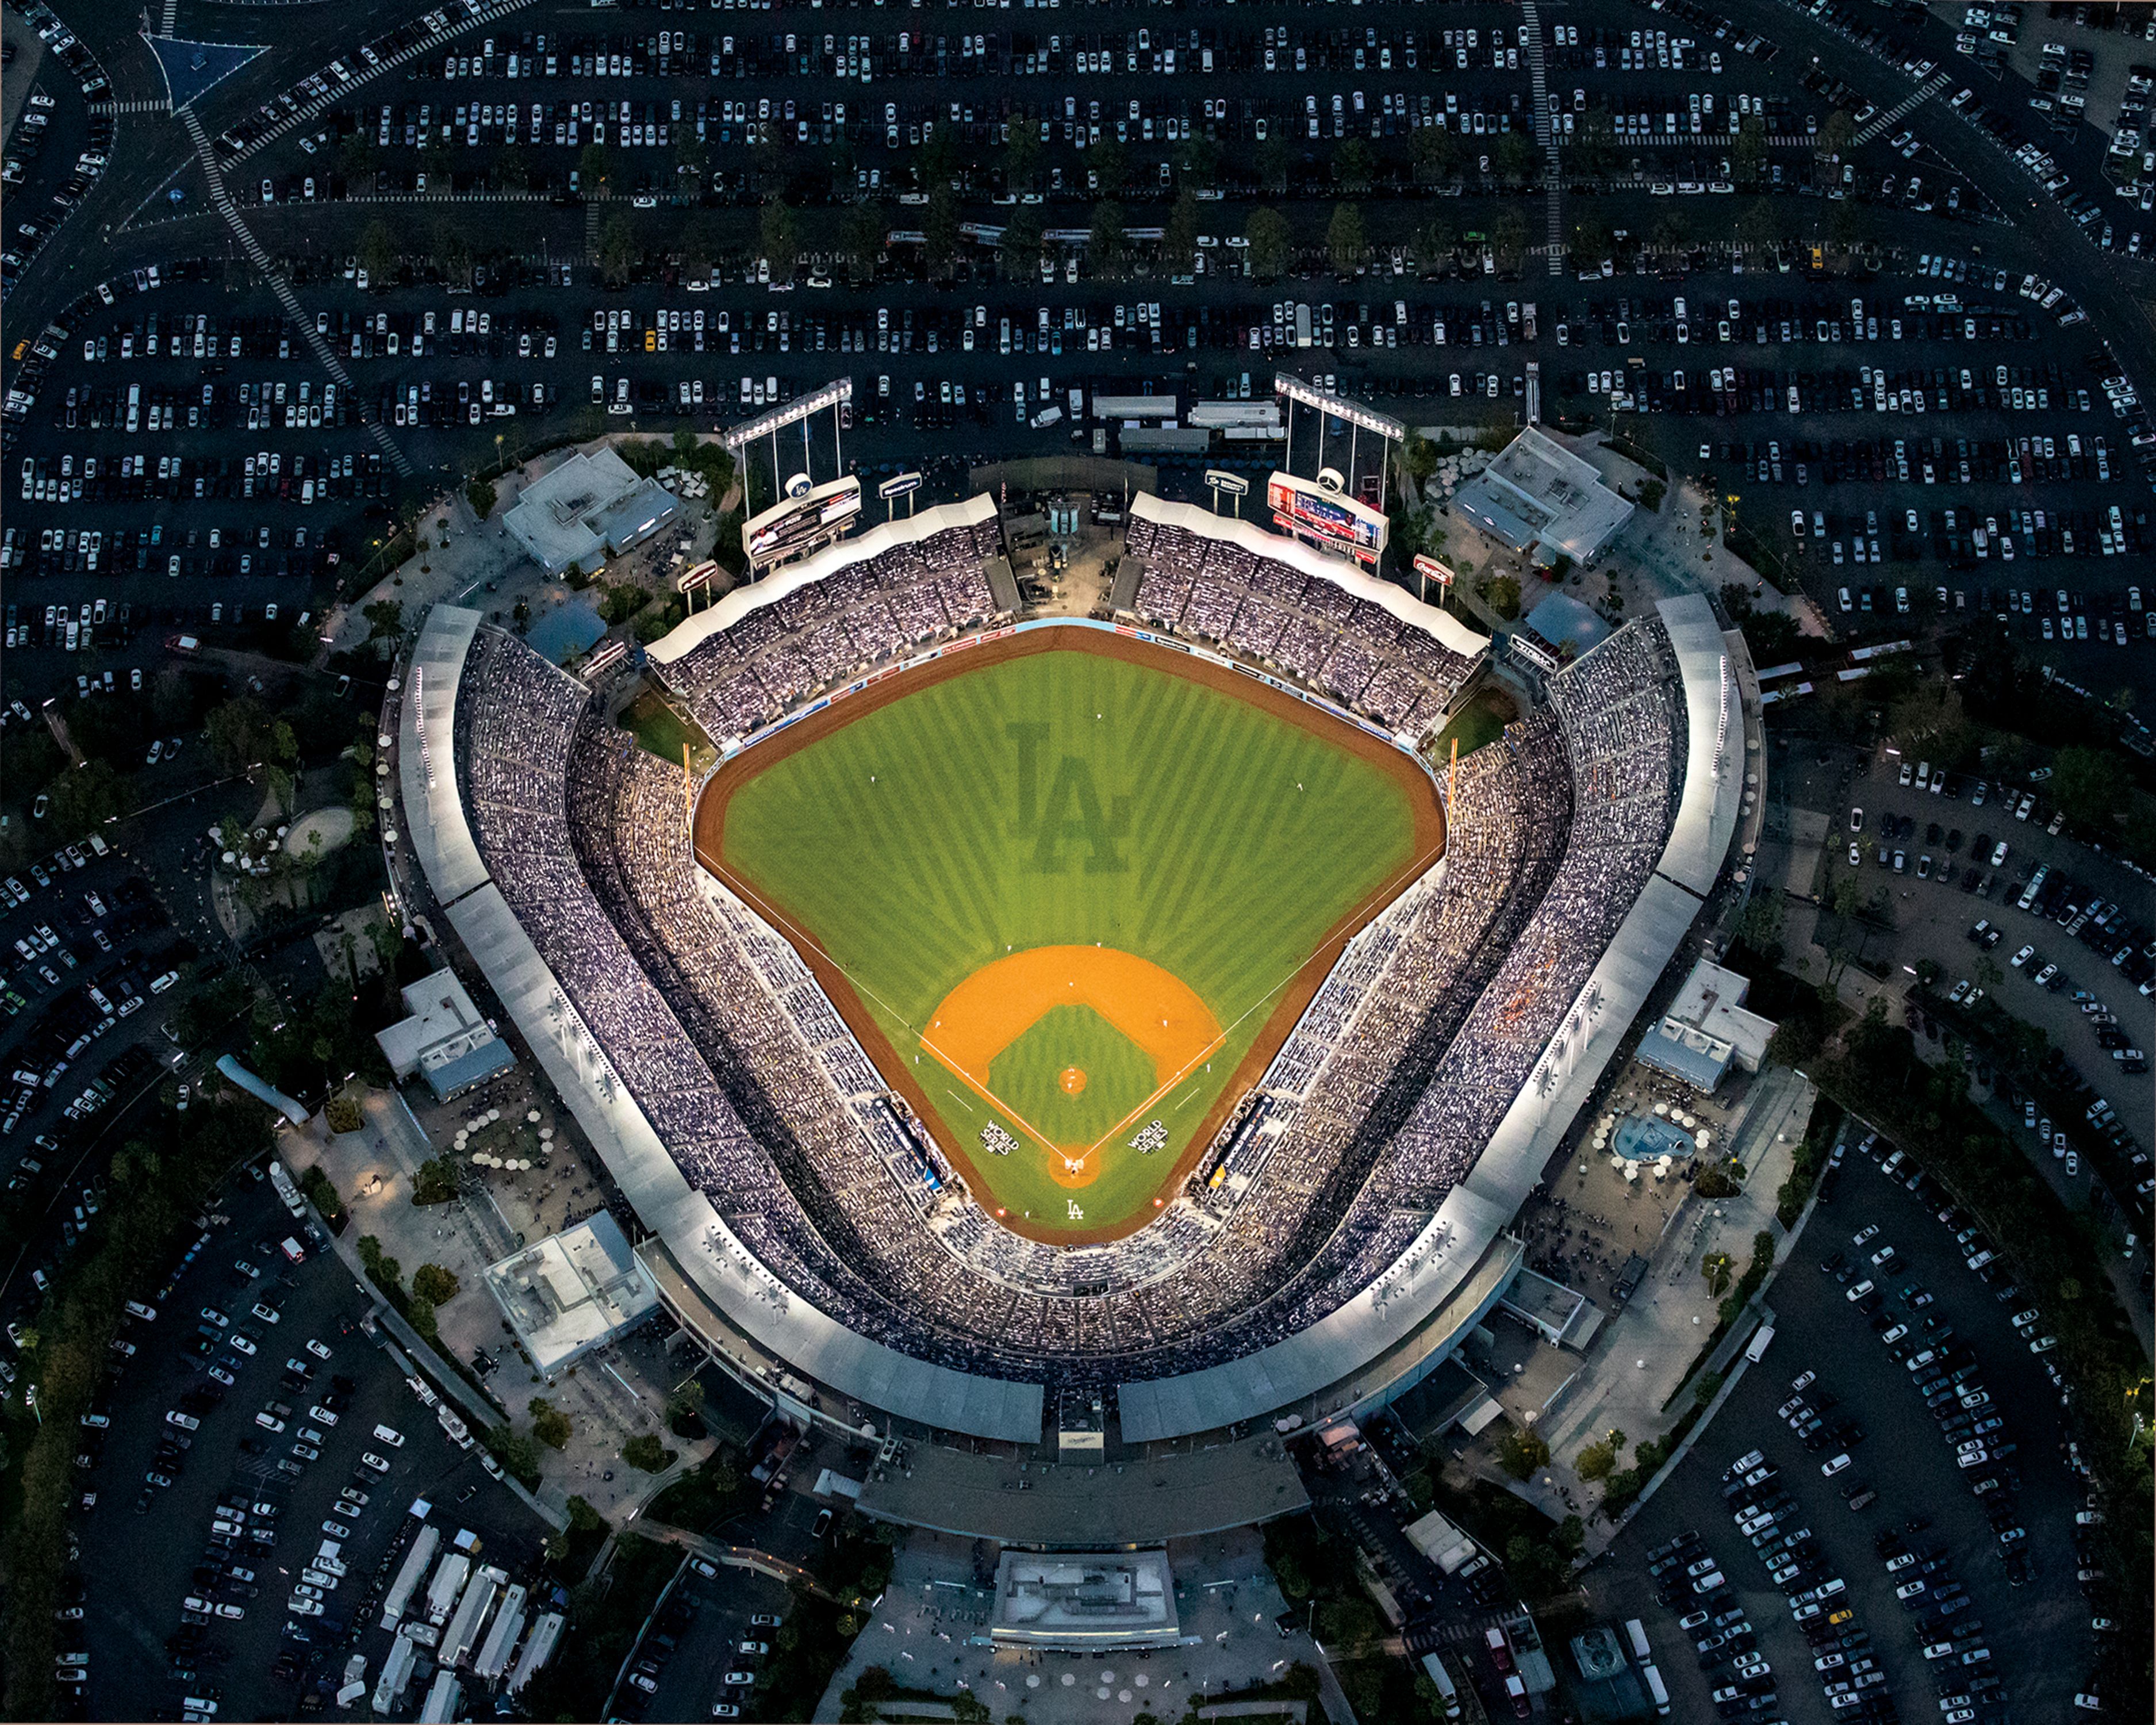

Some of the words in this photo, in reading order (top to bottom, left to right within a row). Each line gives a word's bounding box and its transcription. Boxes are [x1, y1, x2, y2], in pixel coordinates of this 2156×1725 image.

[795, 484, 807, 496] LA
[1006, 722, 1131, 875] LA
[980, 1128, 1011, 1156] SERIES
[987, 1119, 1019, 1150] WORLD
[1127, 1120, 1162, 1148] WORLD
[1137, 1127, 1168, 1154] SERIES
[1067, 1199, 1083, 1220] LA
